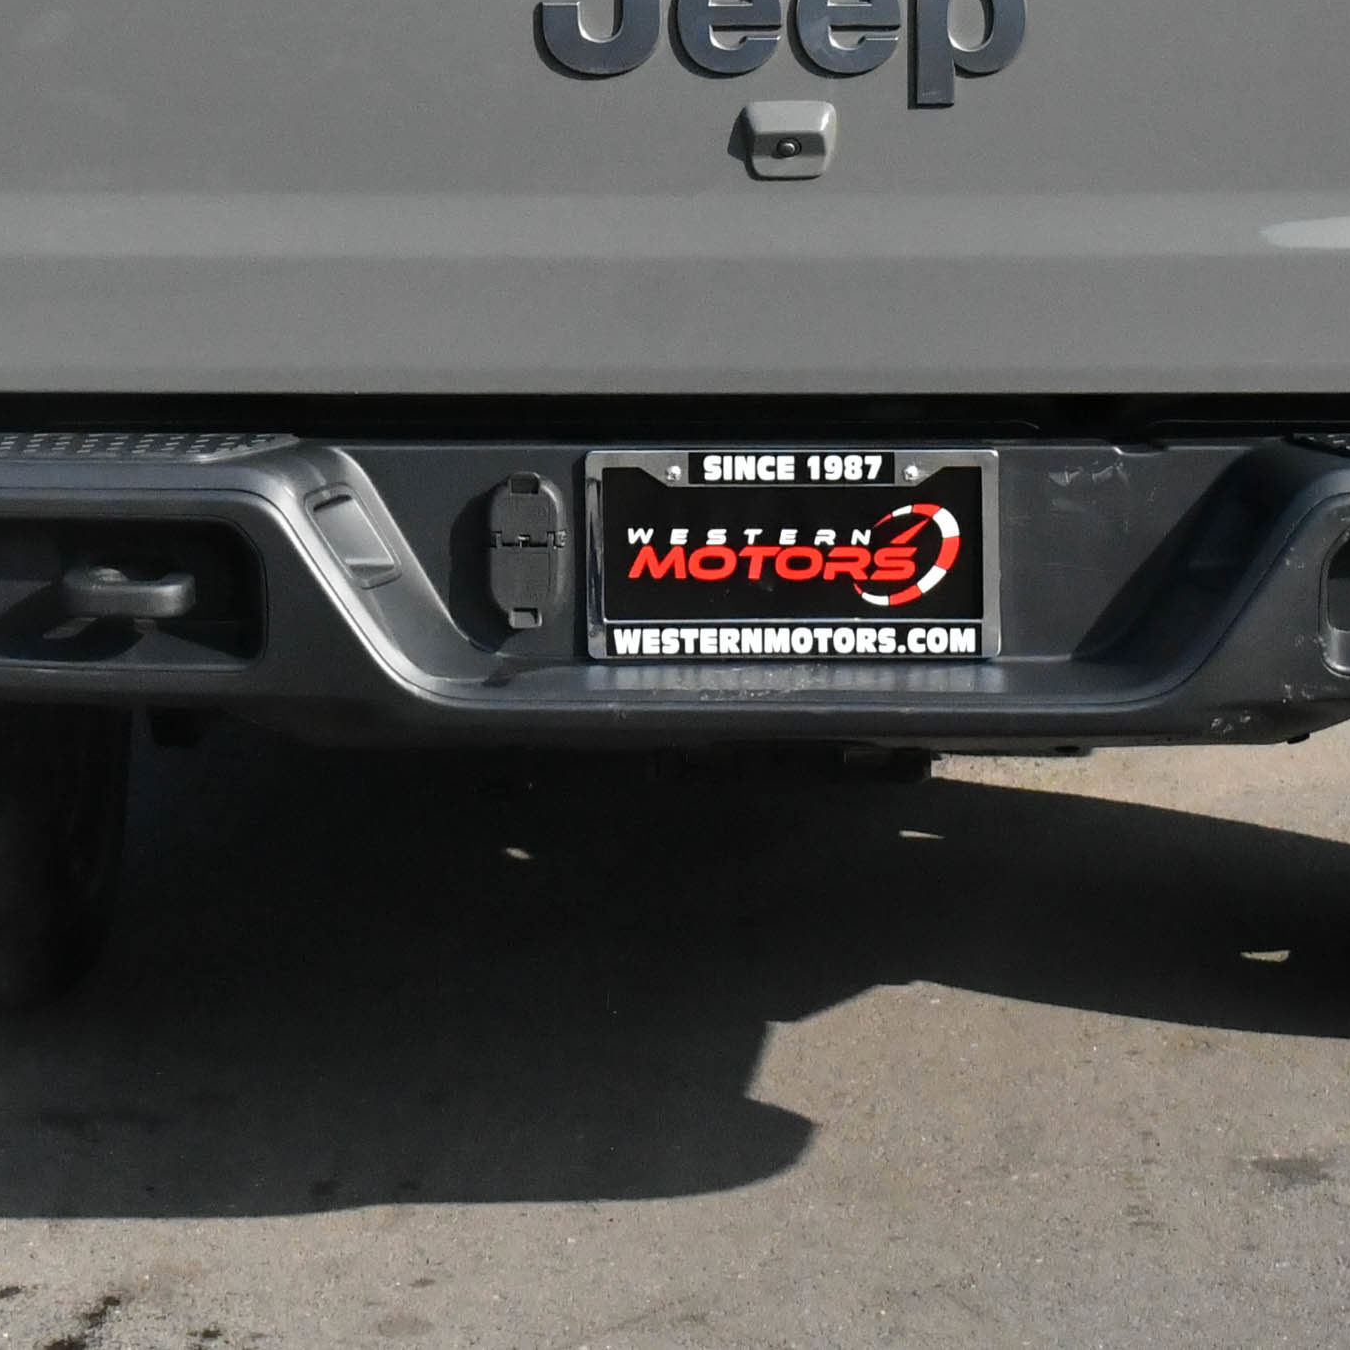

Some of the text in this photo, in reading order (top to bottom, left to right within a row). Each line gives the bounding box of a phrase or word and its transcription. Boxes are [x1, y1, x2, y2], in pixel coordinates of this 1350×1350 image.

[703, 454, 883, 481] SINCE 1987
[627, 527, 872, 546] WESTERN
[628, 545, 918, 581] MOTORS
[613, 627, 976, 655] WESTERNMOTORS.COM
